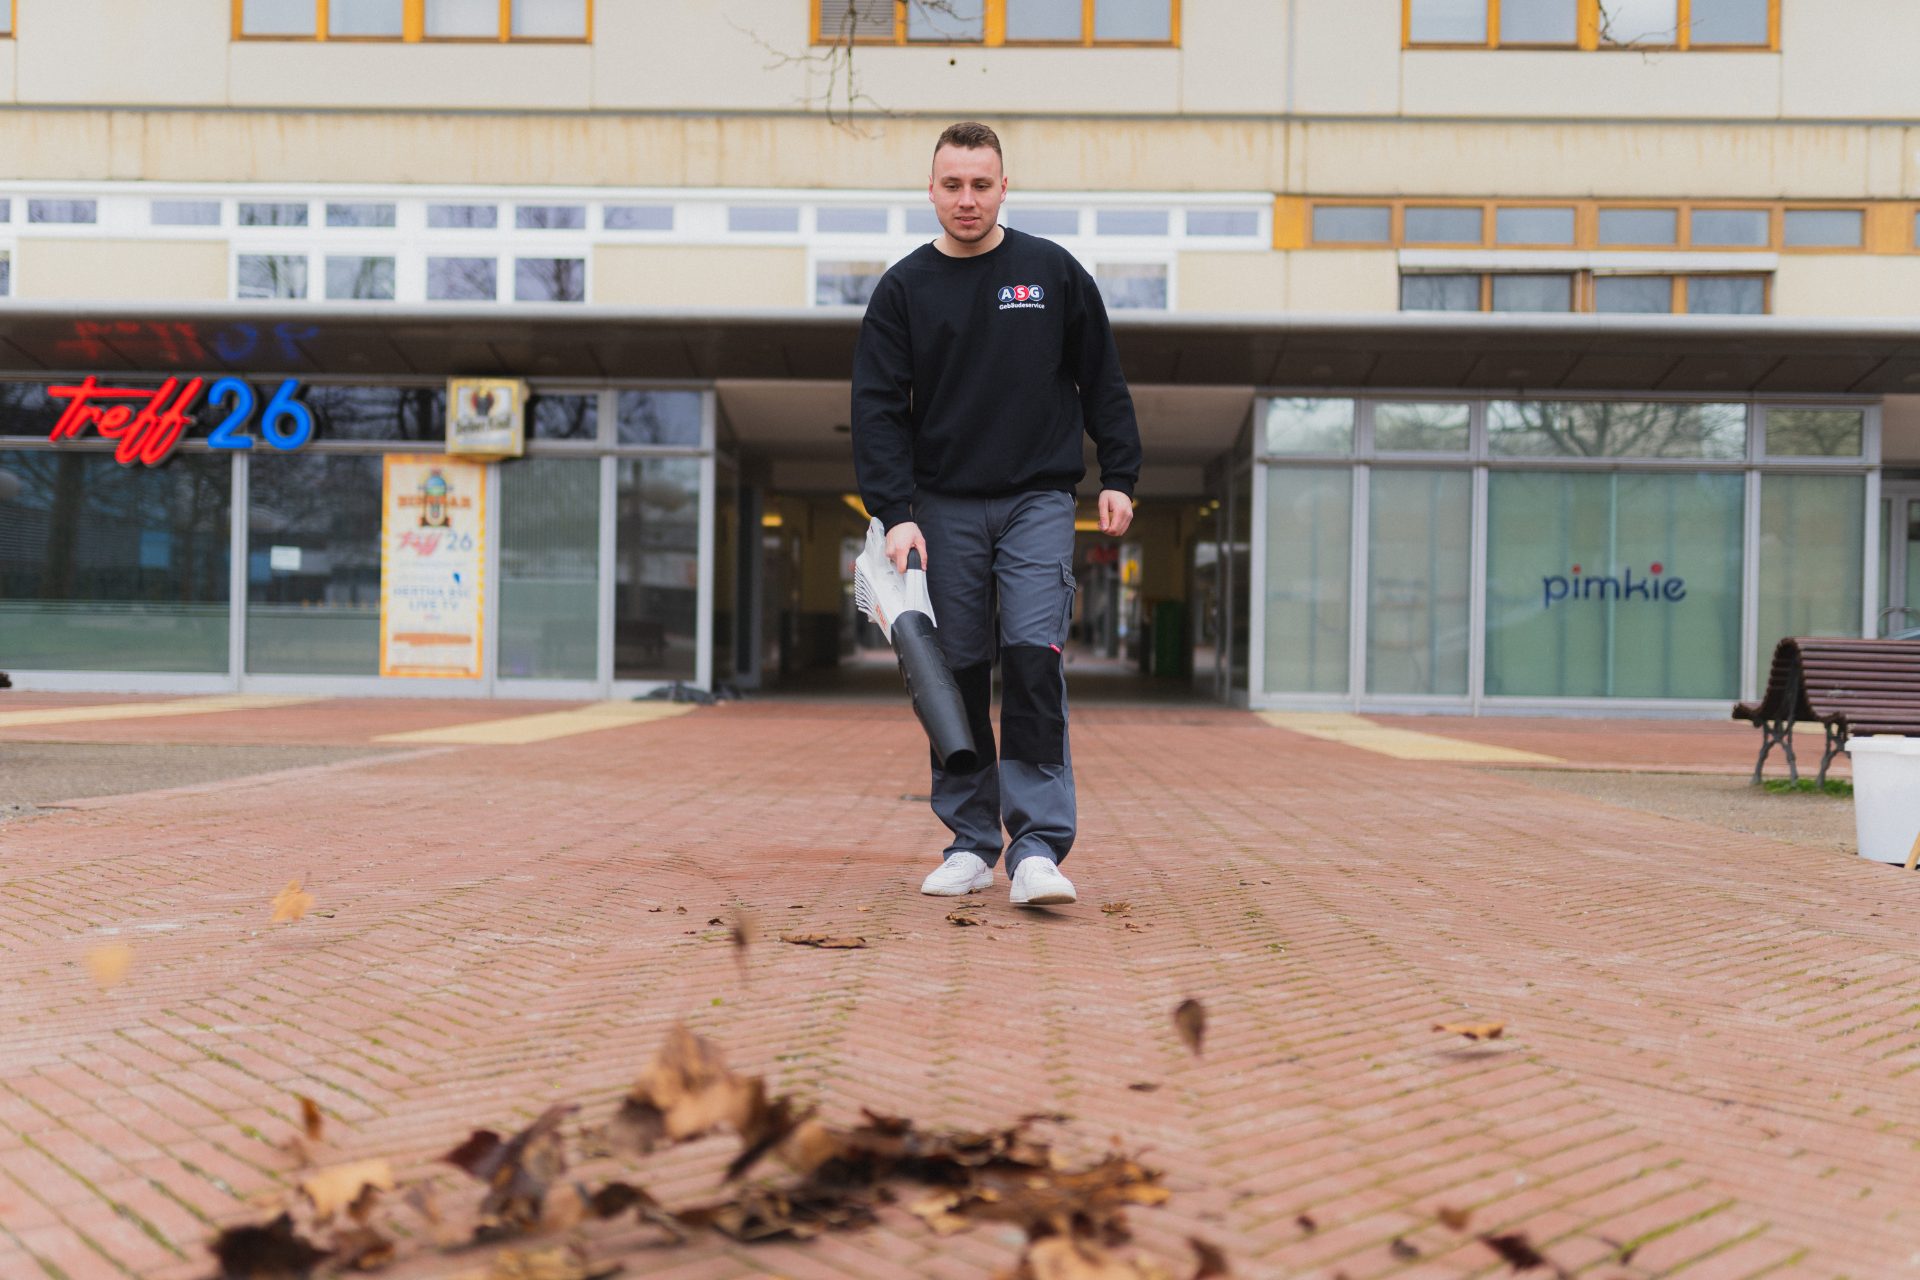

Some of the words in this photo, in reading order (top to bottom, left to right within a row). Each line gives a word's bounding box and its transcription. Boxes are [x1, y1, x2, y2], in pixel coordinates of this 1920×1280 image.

[1001, 286, 1041, 300] ASG
[999, 302, 1045, 310] Gebäudeservice
[207, 376, 313, 451] 26
[446, 531, 473, 552] 26
[1542, 561, 1687, 610] pimkie
